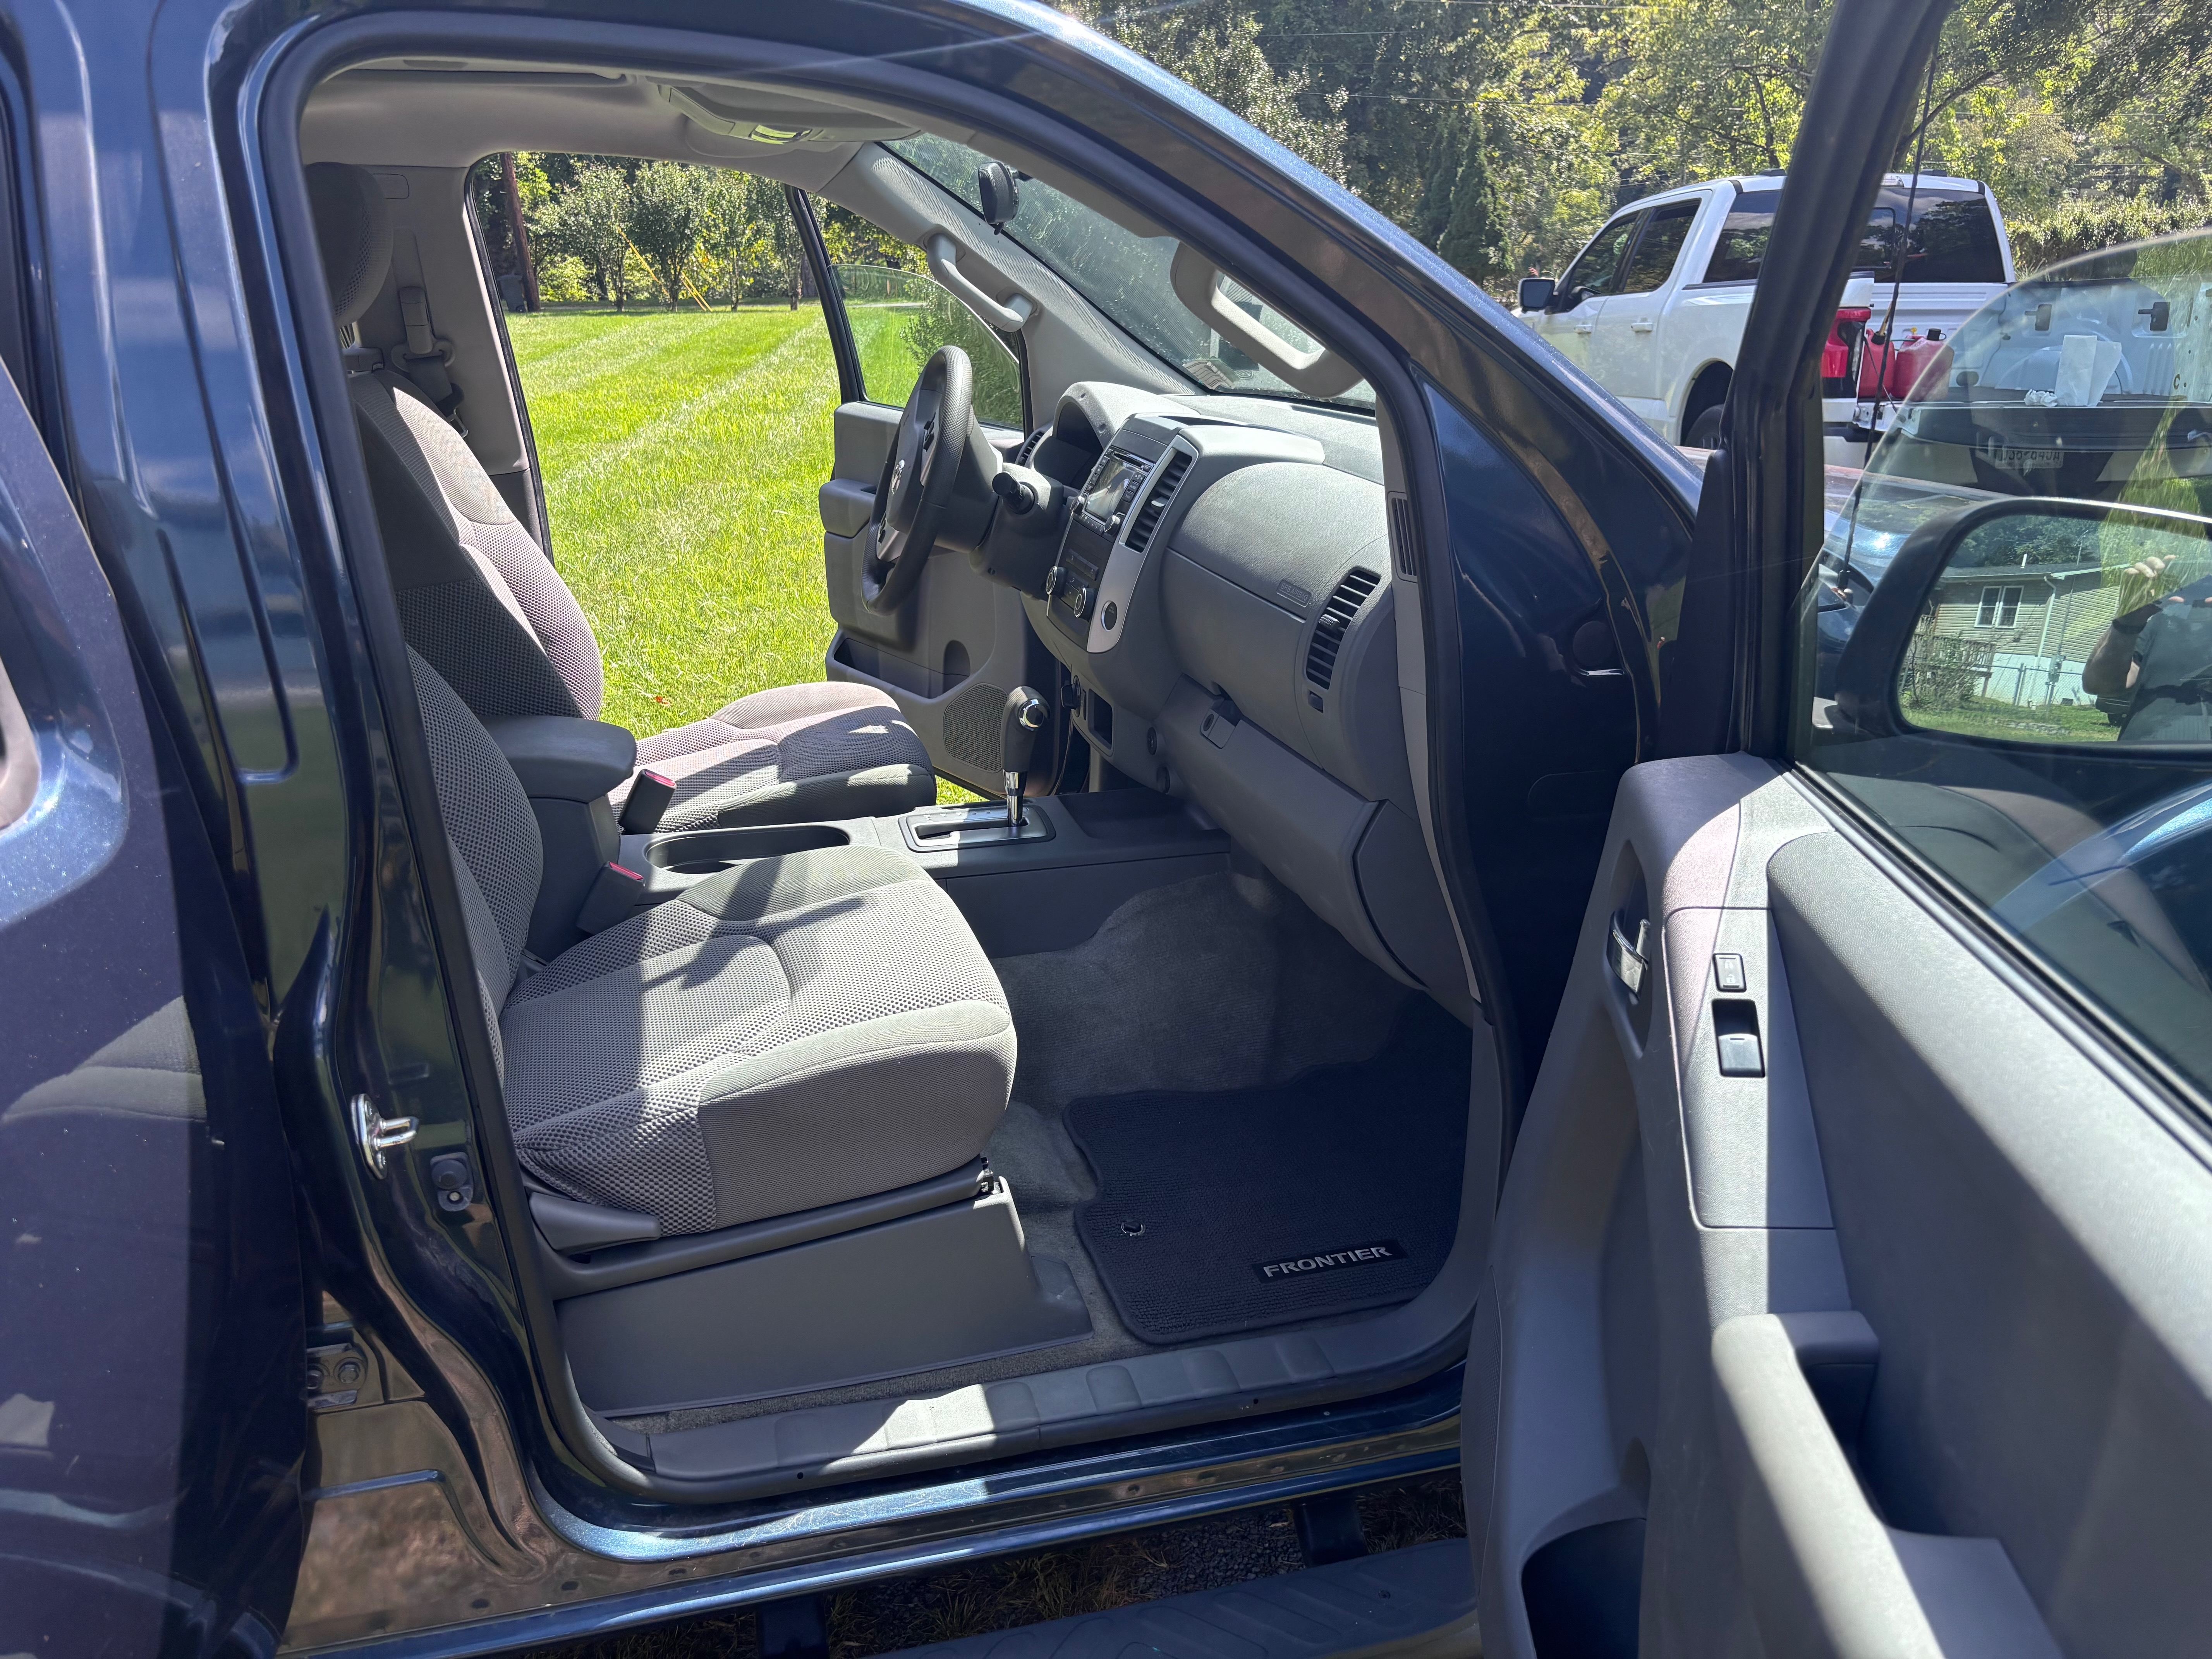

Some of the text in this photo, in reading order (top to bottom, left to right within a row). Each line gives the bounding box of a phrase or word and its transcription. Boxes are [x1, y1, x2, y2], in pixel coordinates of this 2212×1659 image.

[1281, 583, 1308, 601] SRS AIRBAG
[1263, 1246, 1393, 1277] FRONTIER
